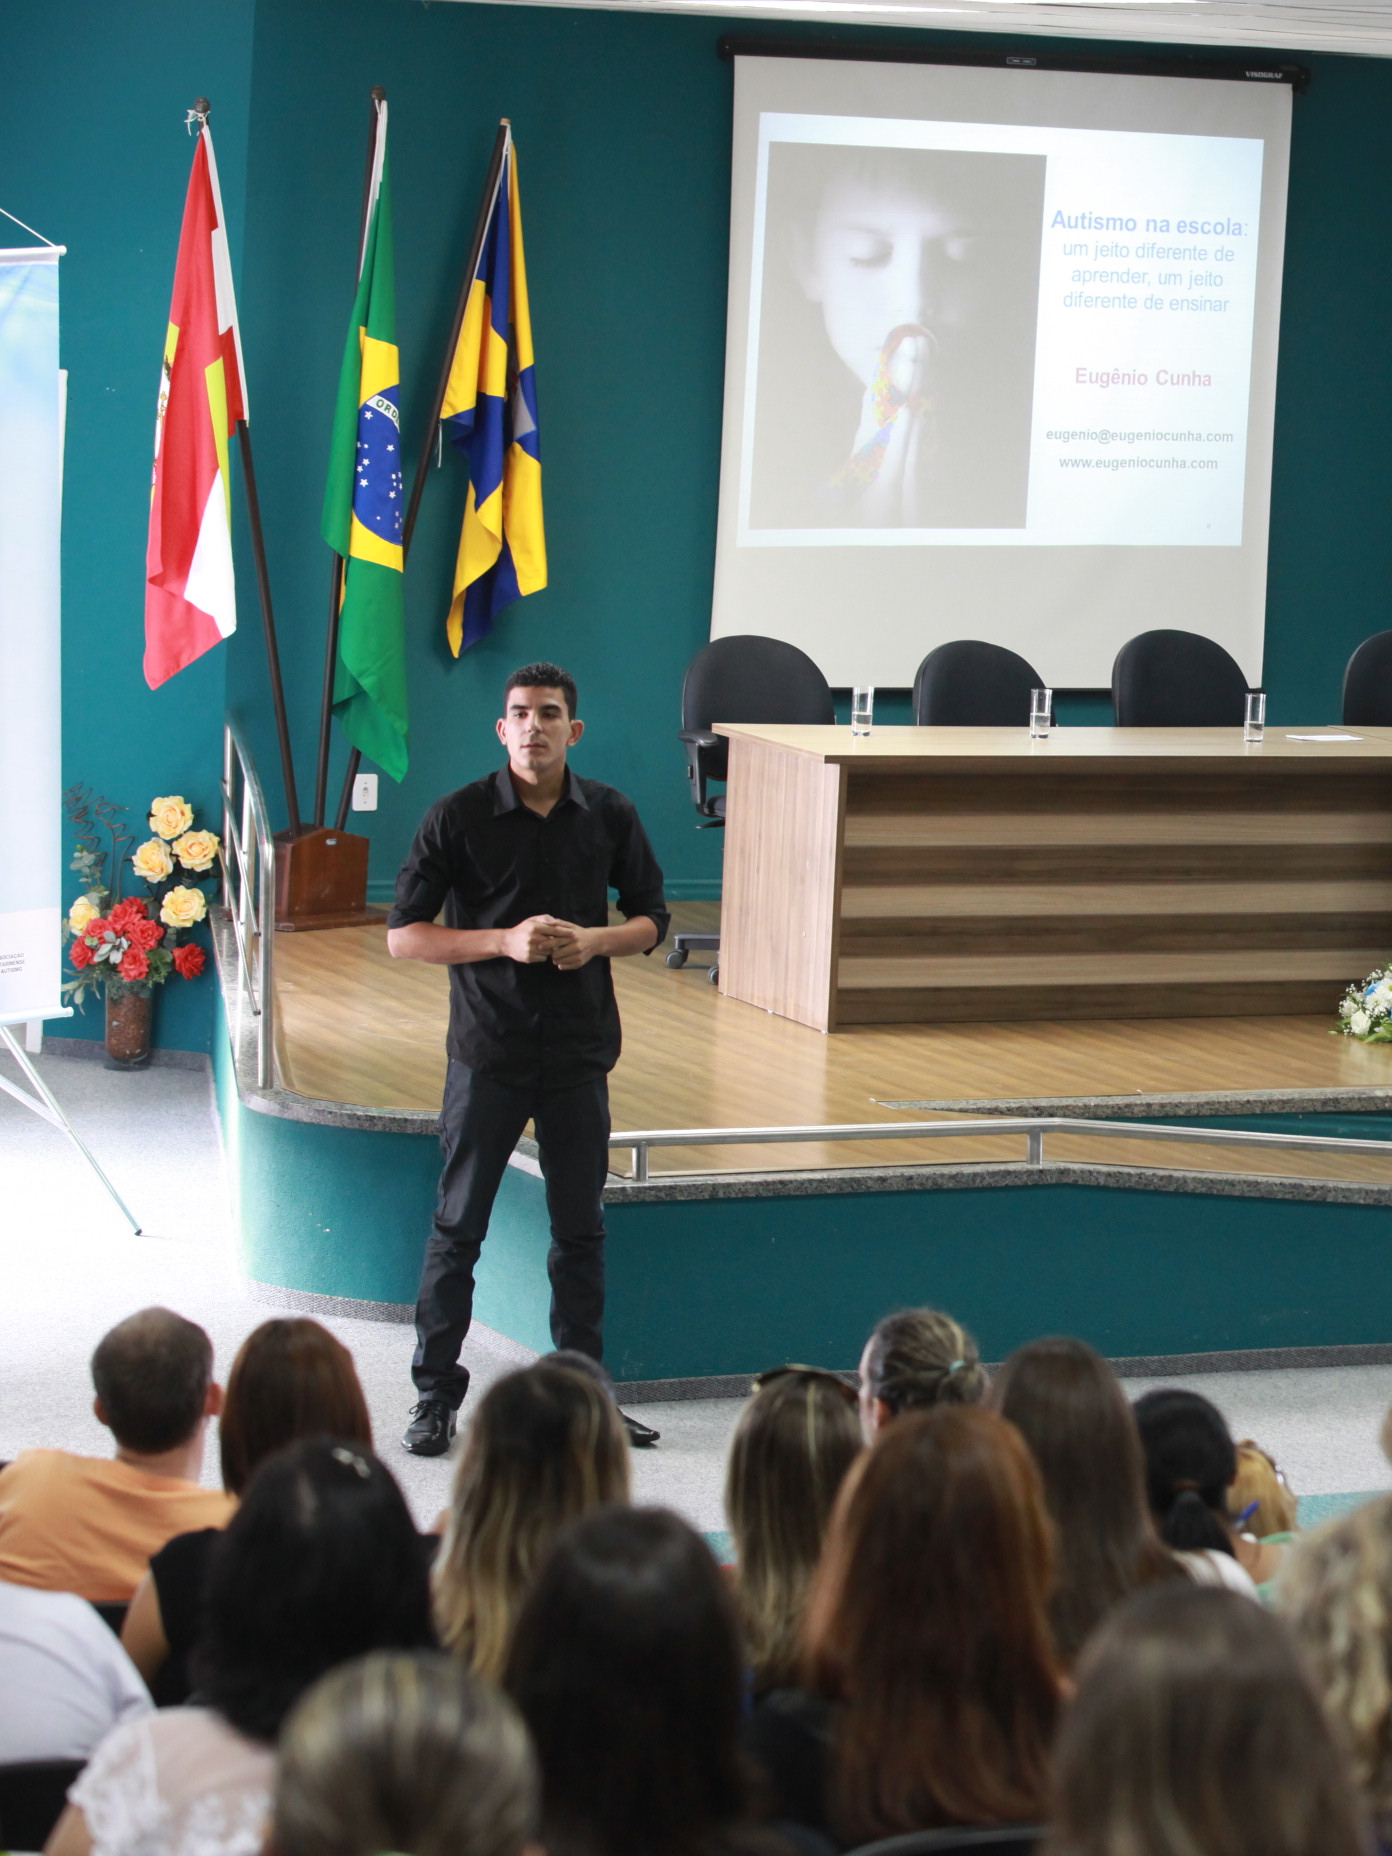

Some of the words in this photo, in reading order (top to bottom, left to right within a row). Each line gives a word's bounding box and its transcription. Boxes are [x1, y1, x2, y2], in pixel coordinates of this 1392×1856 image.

[1245, 70, 1284, 79] VISOGRAF
[1050, 210, 1137, 232] Autismo
[1145, 218, 1170, 233] na
[1176, 217, 1249, 237] escola:
[1062, 243, 1088, 256] um
[1093, 241, 1130, 261] jeito
[1135, 243, 1208, 261] diferente
[1214, 245, 1235, 262] de
[1071, 268, 1151, 287] aprender,
[1158, 272, 1183, 286] um
[1187, 270, 1224, 290] jeito
[1062, 291, 1138, 309] diferente
[1143, 294, 1164, 310] de
[1169, 295, 1230, 312] ensinar
[1075, 367, 1148, 388] Eugênio
[1155, 369, 1212, 387] Cunha
[1046, 429, 1234, 445] eugenio@eugeniocunha.com
[1059, 456, 1218, 471] www.eugeniocunha.com
